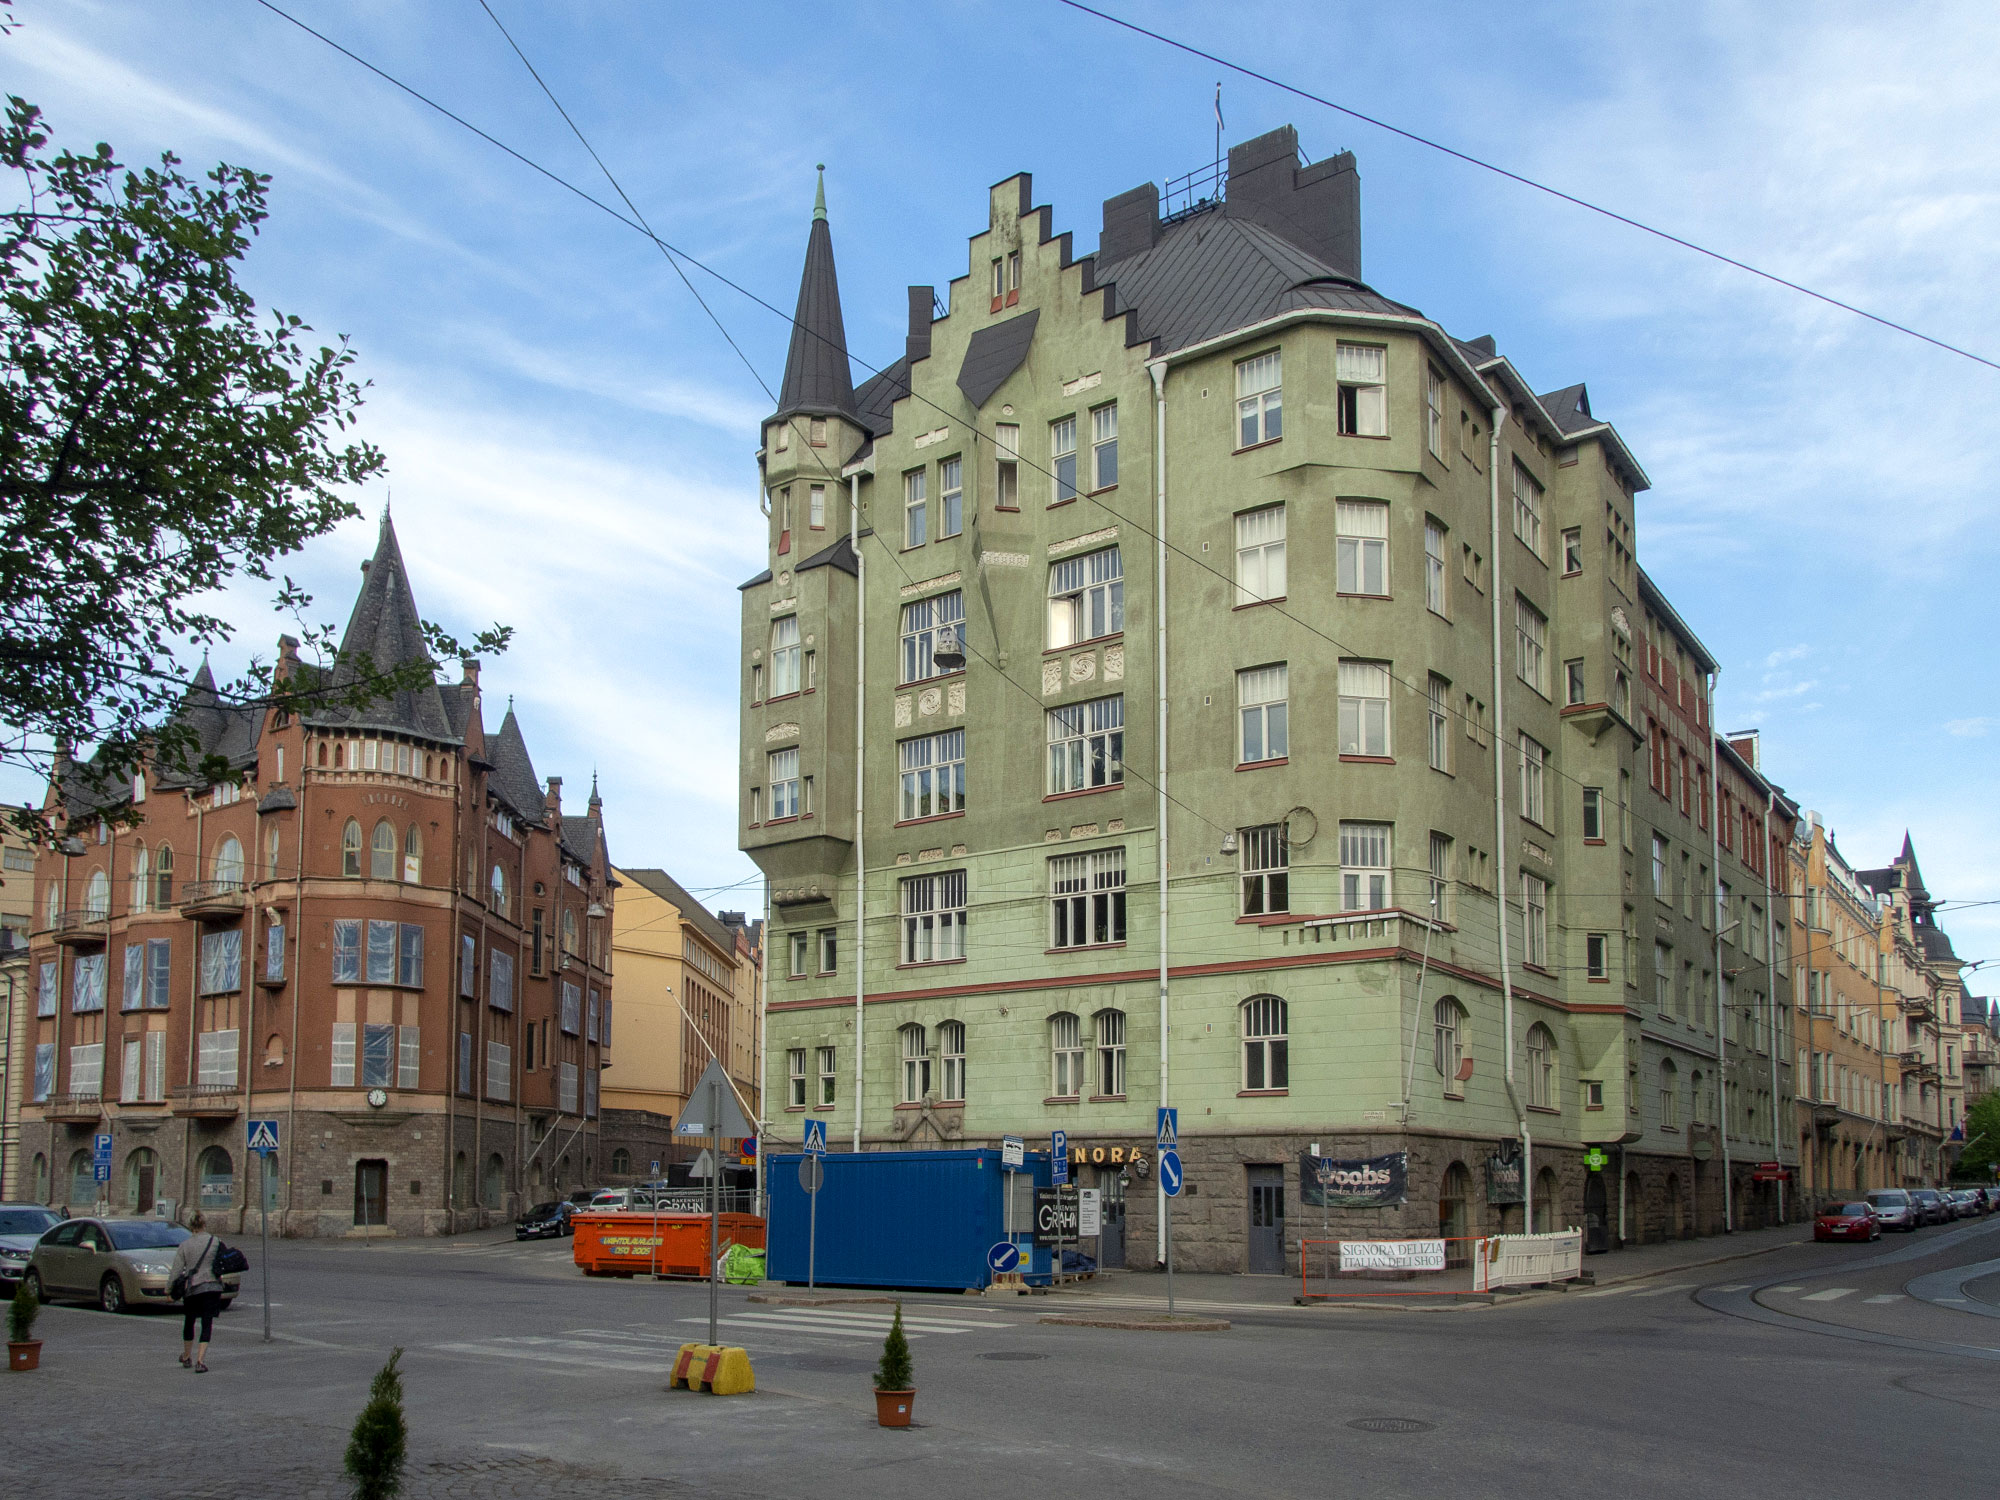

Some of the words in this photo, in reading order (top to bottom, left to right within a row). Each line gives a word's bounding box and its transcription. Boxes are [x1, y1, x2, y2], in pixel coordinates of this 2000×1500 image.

[98, 1135, 110, 1149] P
[1054, 1133, 1065, 1157] P
[1343, 1244, 1395, 1256] SIGNORA
[1398, 1243, 1444, 1255] DELIZIA
[1344, 1257, 1385, 1268] ITALIAN
[1388, 1257, 1412, 1268] DELI
[1414, 1255, 1443, 1267] SHOP
